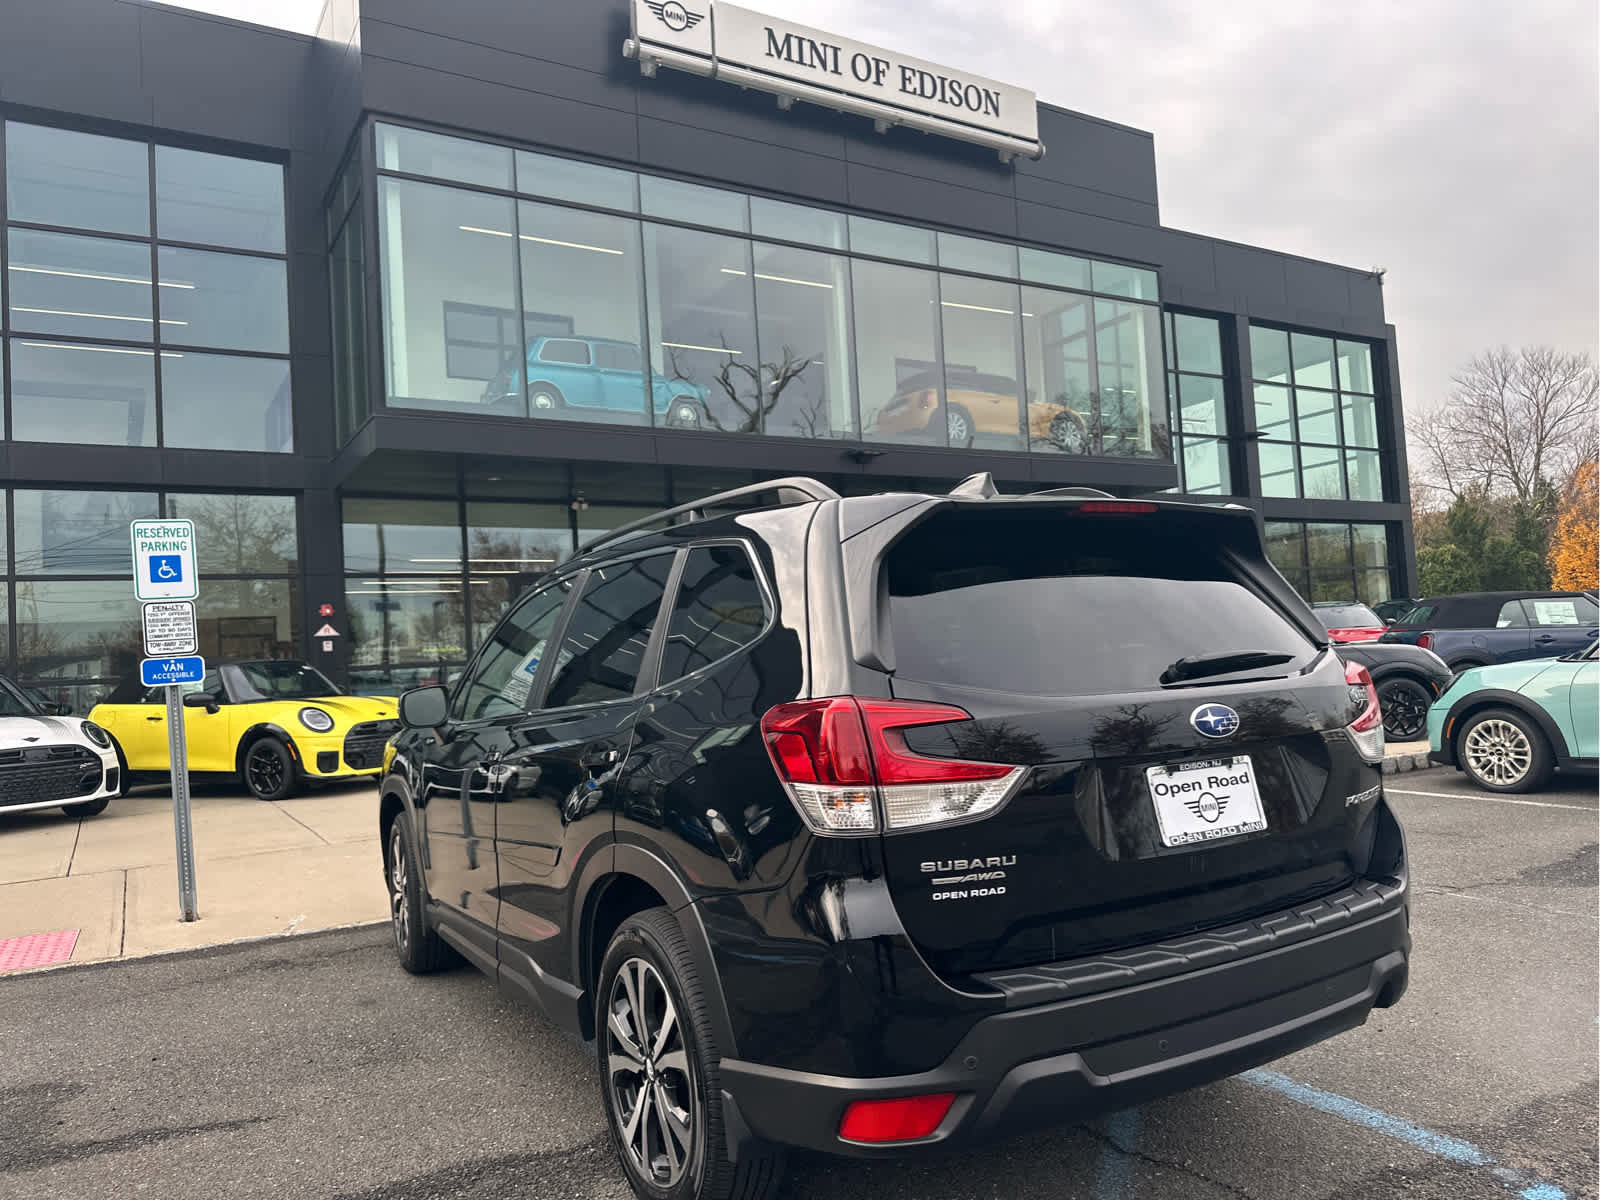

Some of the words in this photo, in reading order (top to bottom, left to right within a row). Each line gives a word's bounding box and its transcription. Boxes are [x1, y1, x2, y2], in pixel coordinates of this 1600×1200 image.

[665, 9, 685, 23] MINI
[764, 27, 843, 76] MINI
[851, 52, 890, 86] OF
[898, 64, 1001, 118] EDISON
[136, 527, 190, 539] RESERVED
[141, 541, 187, 552] PARKING
[162, 662, 184, 672] VAN
[152, 671, 195, 680] ACCESSIBLE
[1154, 781, 1202, 798] Open
[1207, 772, 1250, 789] Road
[1201, 802, 1218, 812] MINI
[1170, 832, 1203, 845] OPEN
[1206, 827, 1237, 840] ROAD
[1240, 821, 1264, 833] MINI
[920, 855, 1017, 872] SUBARU
[932, 891, 968, 901] OPEN
[970, 886, 1007, 898] ROAD
